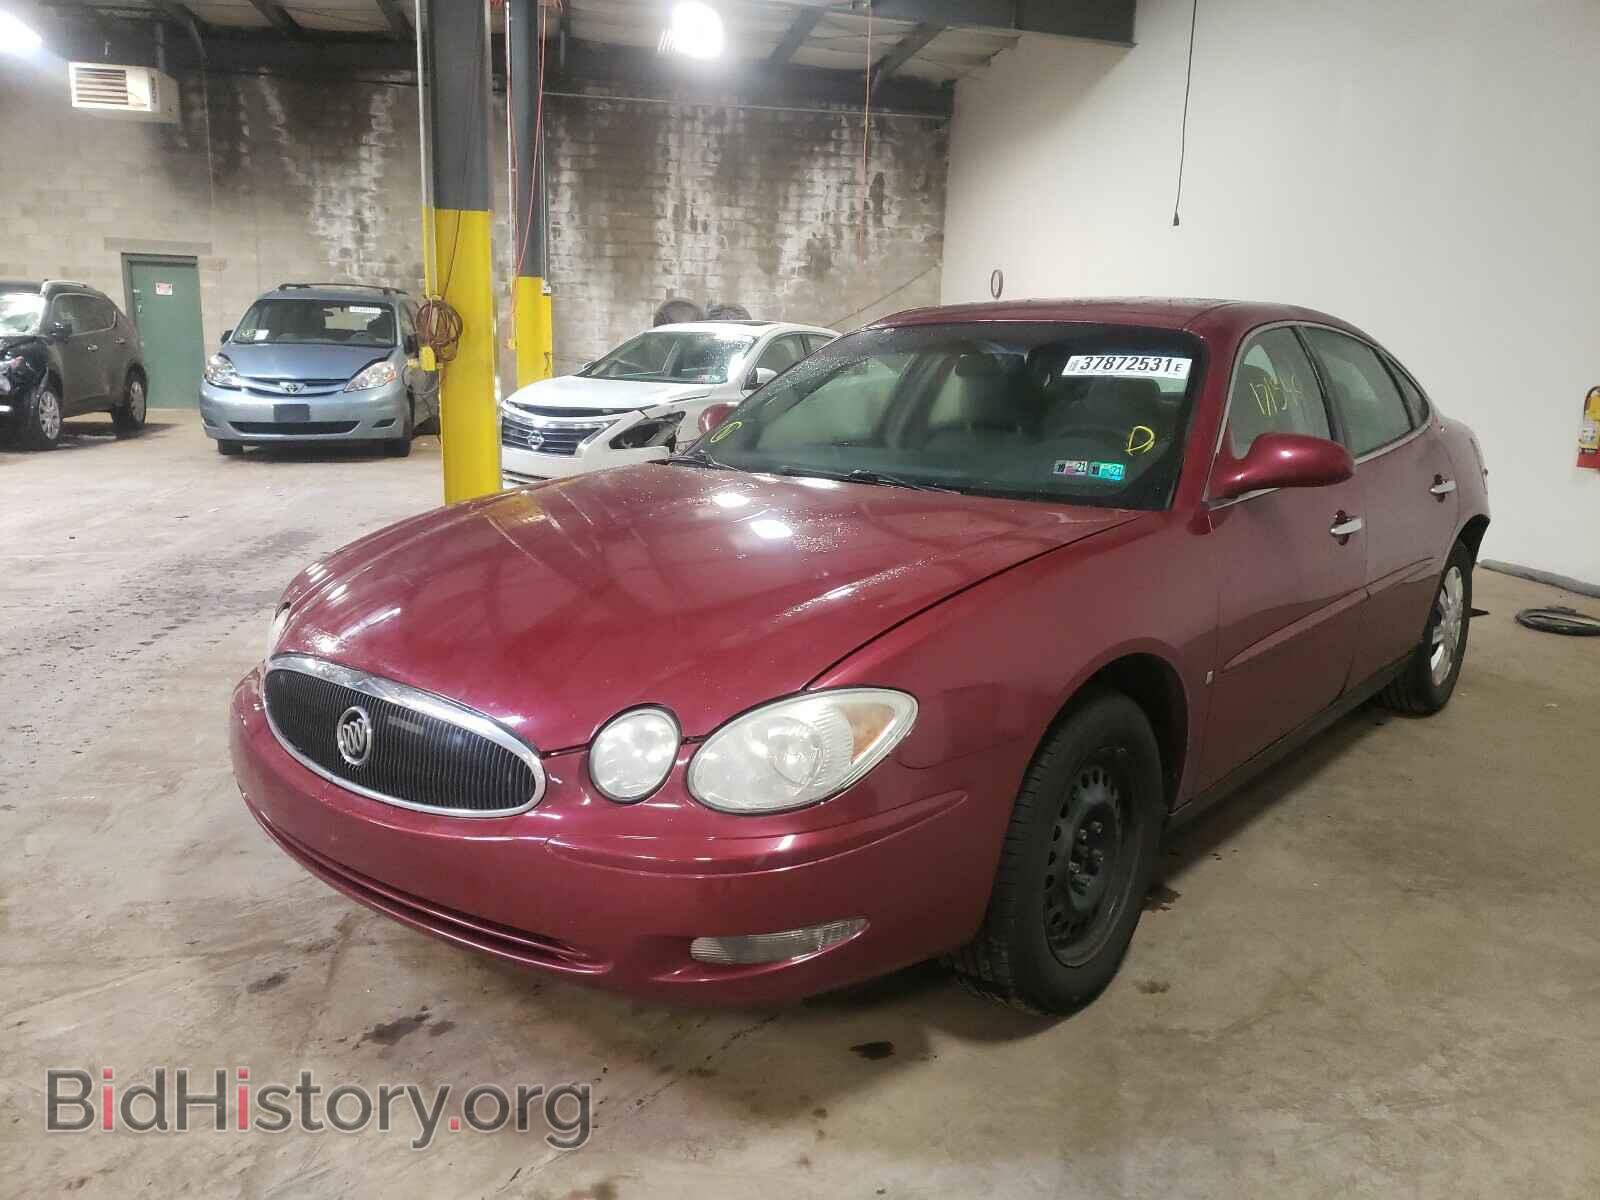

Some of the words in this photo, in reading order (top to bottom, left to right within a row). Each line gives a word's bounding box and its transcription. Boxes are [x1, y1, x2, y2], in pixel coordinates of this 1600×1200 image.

[1079, 356, 1173, 373] 37872531
[1174, 363, 1184, 372] E
[1123, 425, 1155, 457] D
